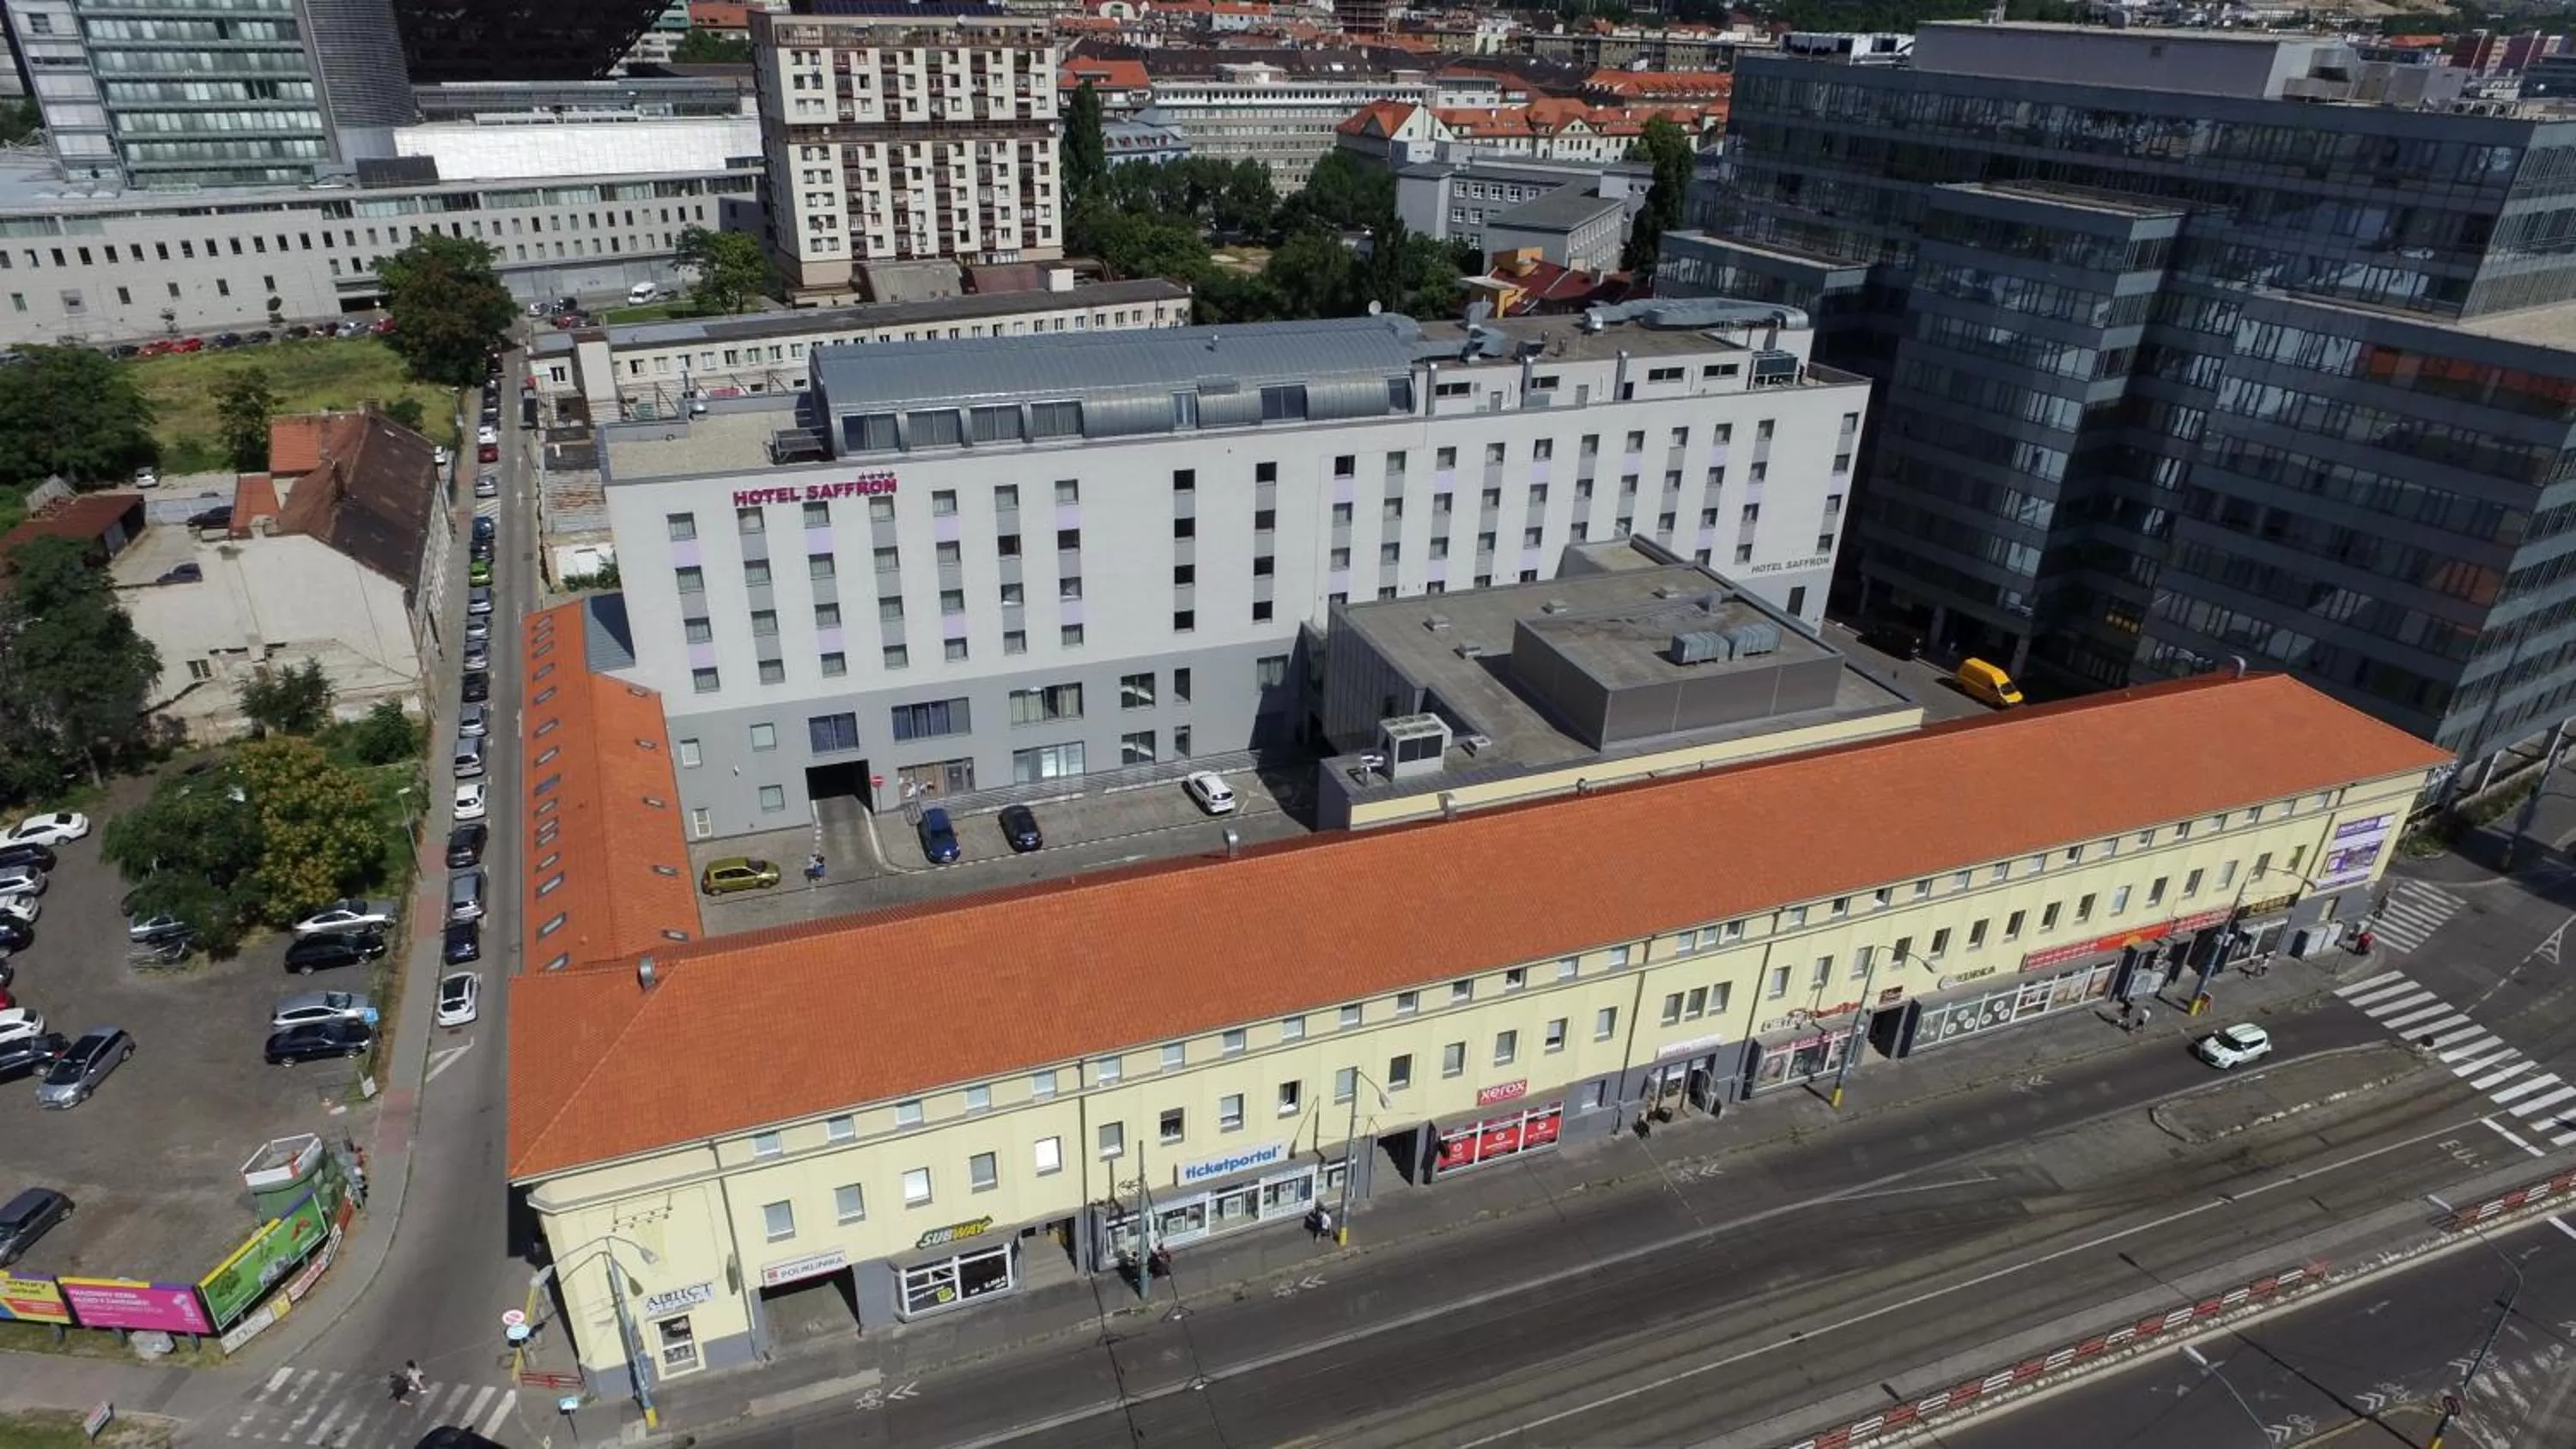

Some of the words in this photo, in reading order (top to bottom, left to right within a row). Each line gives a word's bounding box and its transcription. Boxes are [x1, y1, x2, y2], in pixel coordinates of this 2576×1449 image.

[733, 487, 801, 506] HOTEL
[806, 478, 897, 500] SAFFRON
[1751, 562, 1783, 574] HOTEL
[1786, 557, 1830, 569] SAFFRON
[1186, 1145, 1278, 1179] ticketportal
[917, 1216, 992, 1249] SUBWAY
